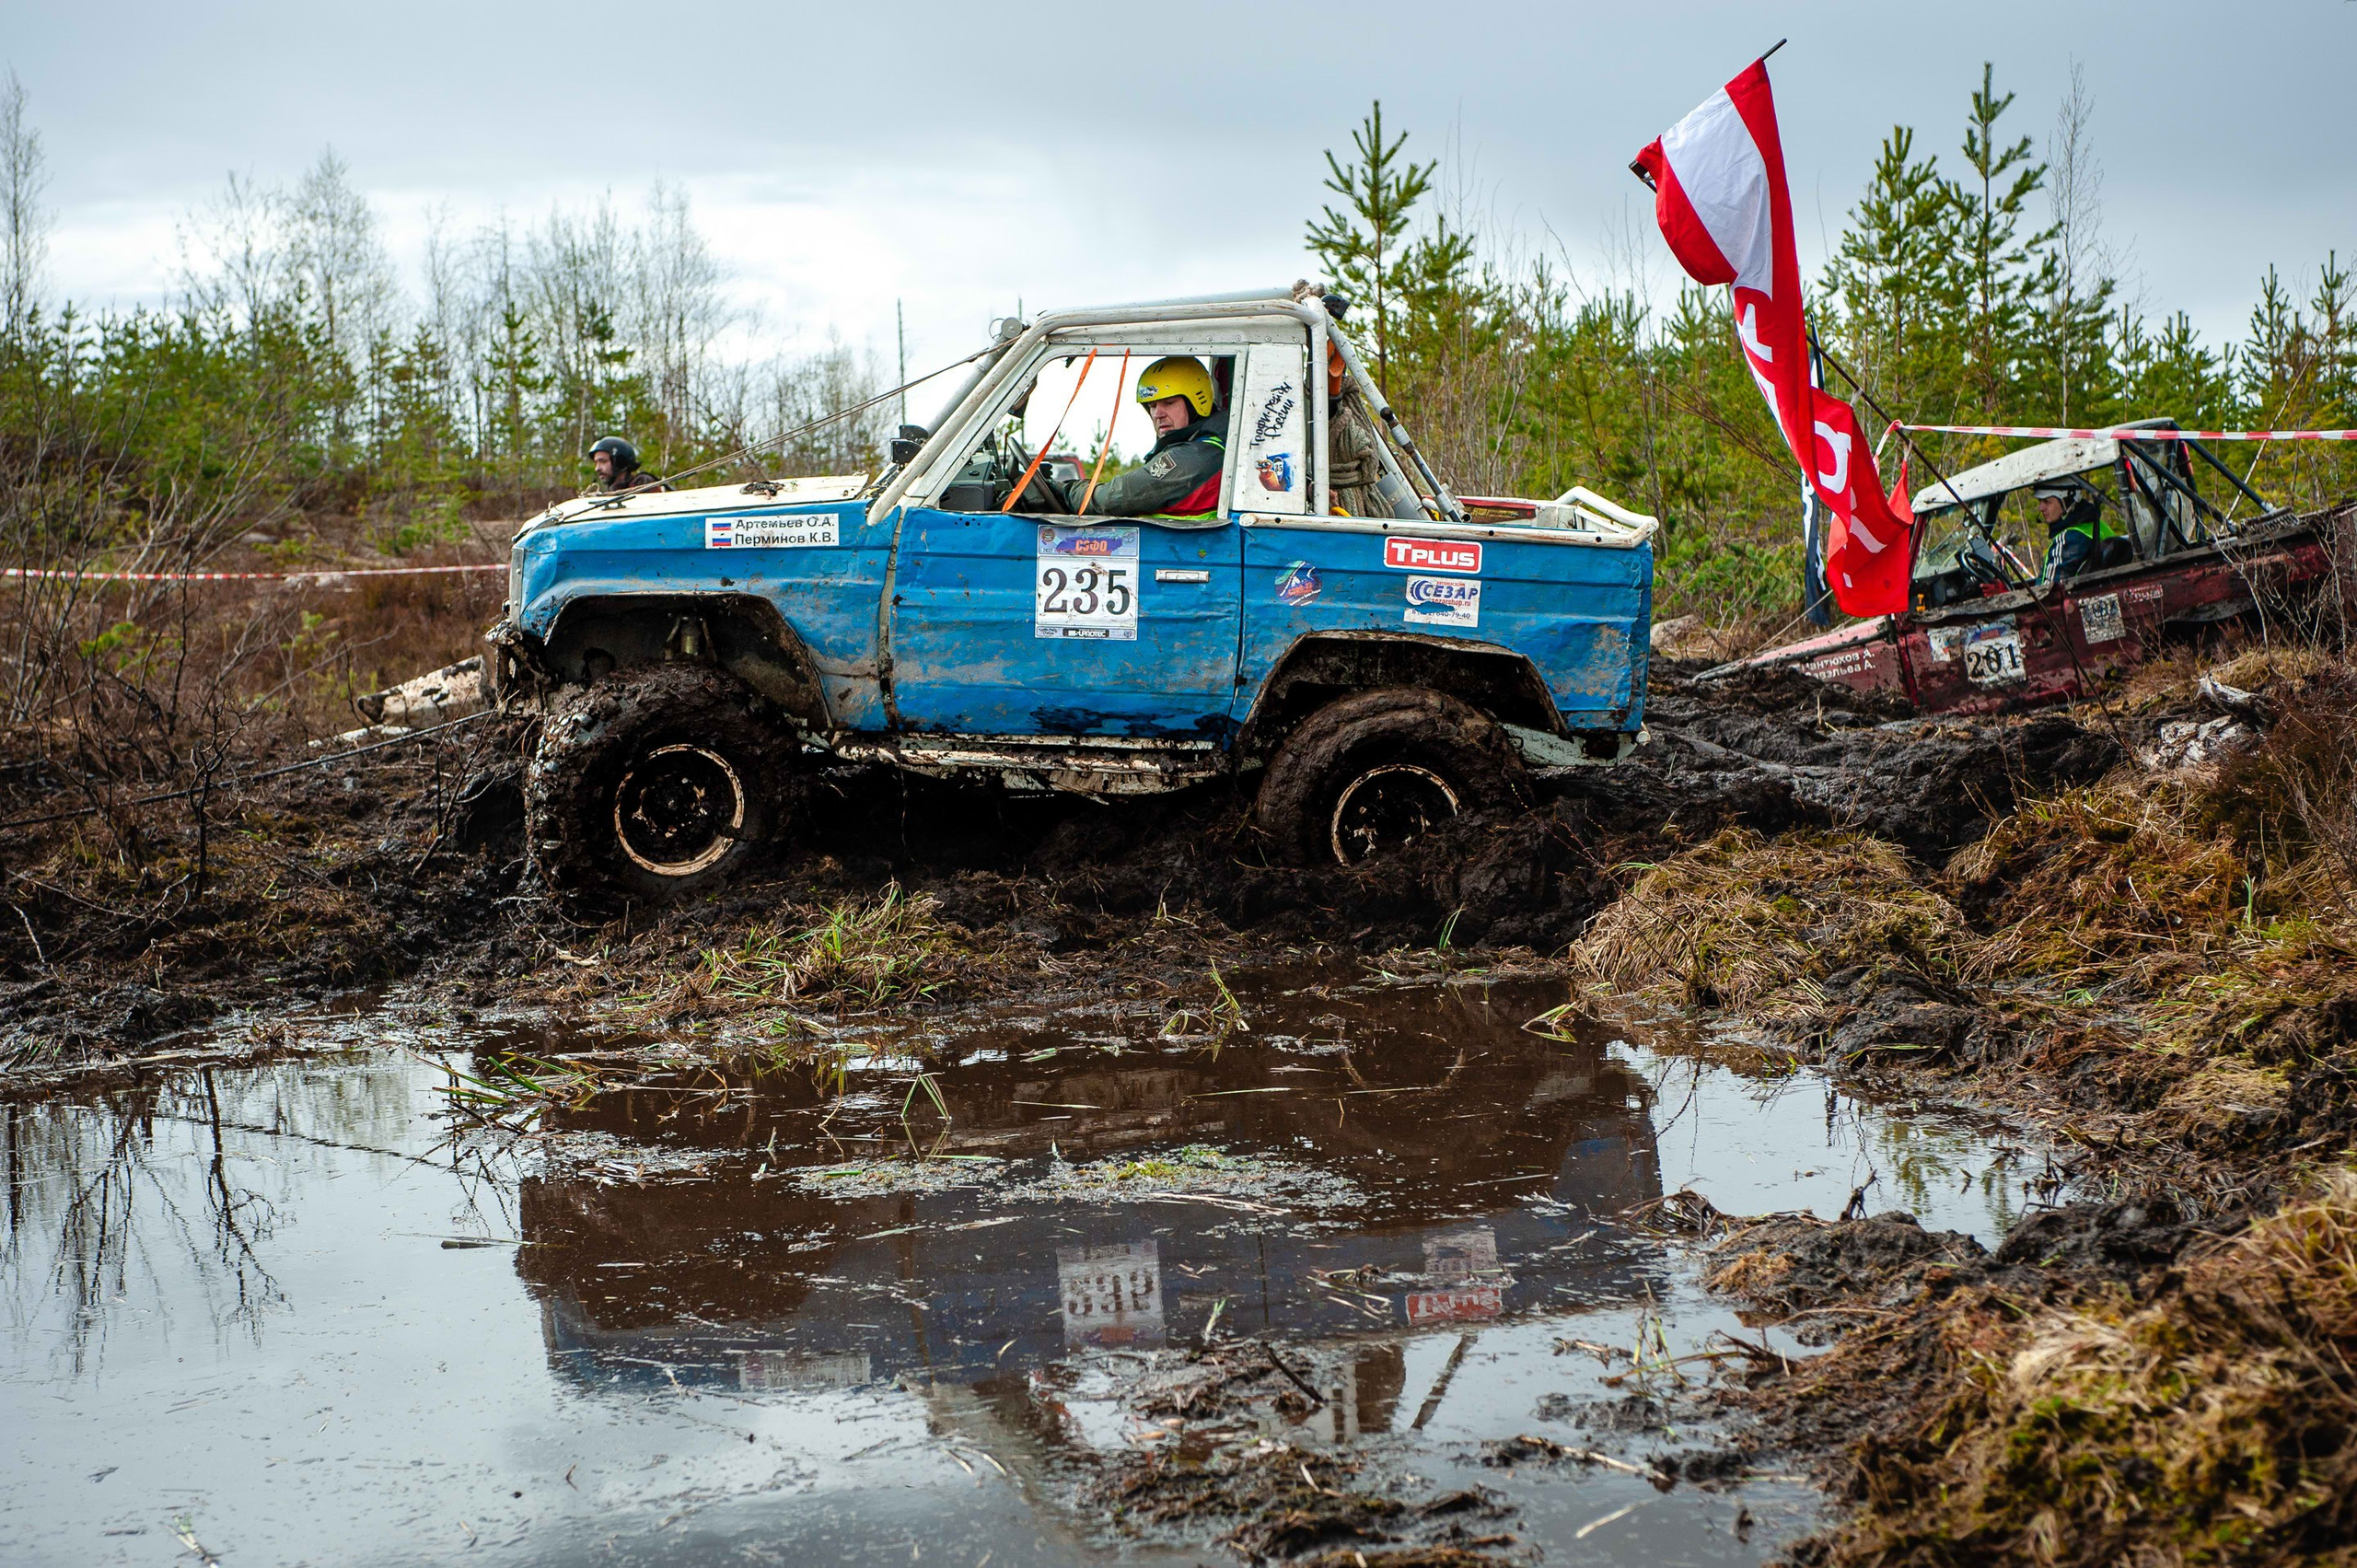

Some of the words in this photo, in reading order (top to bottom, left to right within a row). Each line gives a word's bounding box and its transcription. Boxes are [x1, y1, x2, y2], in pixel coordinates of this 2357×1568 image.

[1264, 399, 1295, 439] России
[736, 518, 802, 530] Артемьев
[807, 516, 835, 528] О.А.
[736, 533, 805, 546] Перминов
[809, 531, 835, 543] К.В.
[1075, 540, 1108, 552] СЗФО
[1042, 568, 1130, 615] 235
[1423, 585, 1479, 599] СЕЗАР
[1968, 643, 2020, 679] 201
